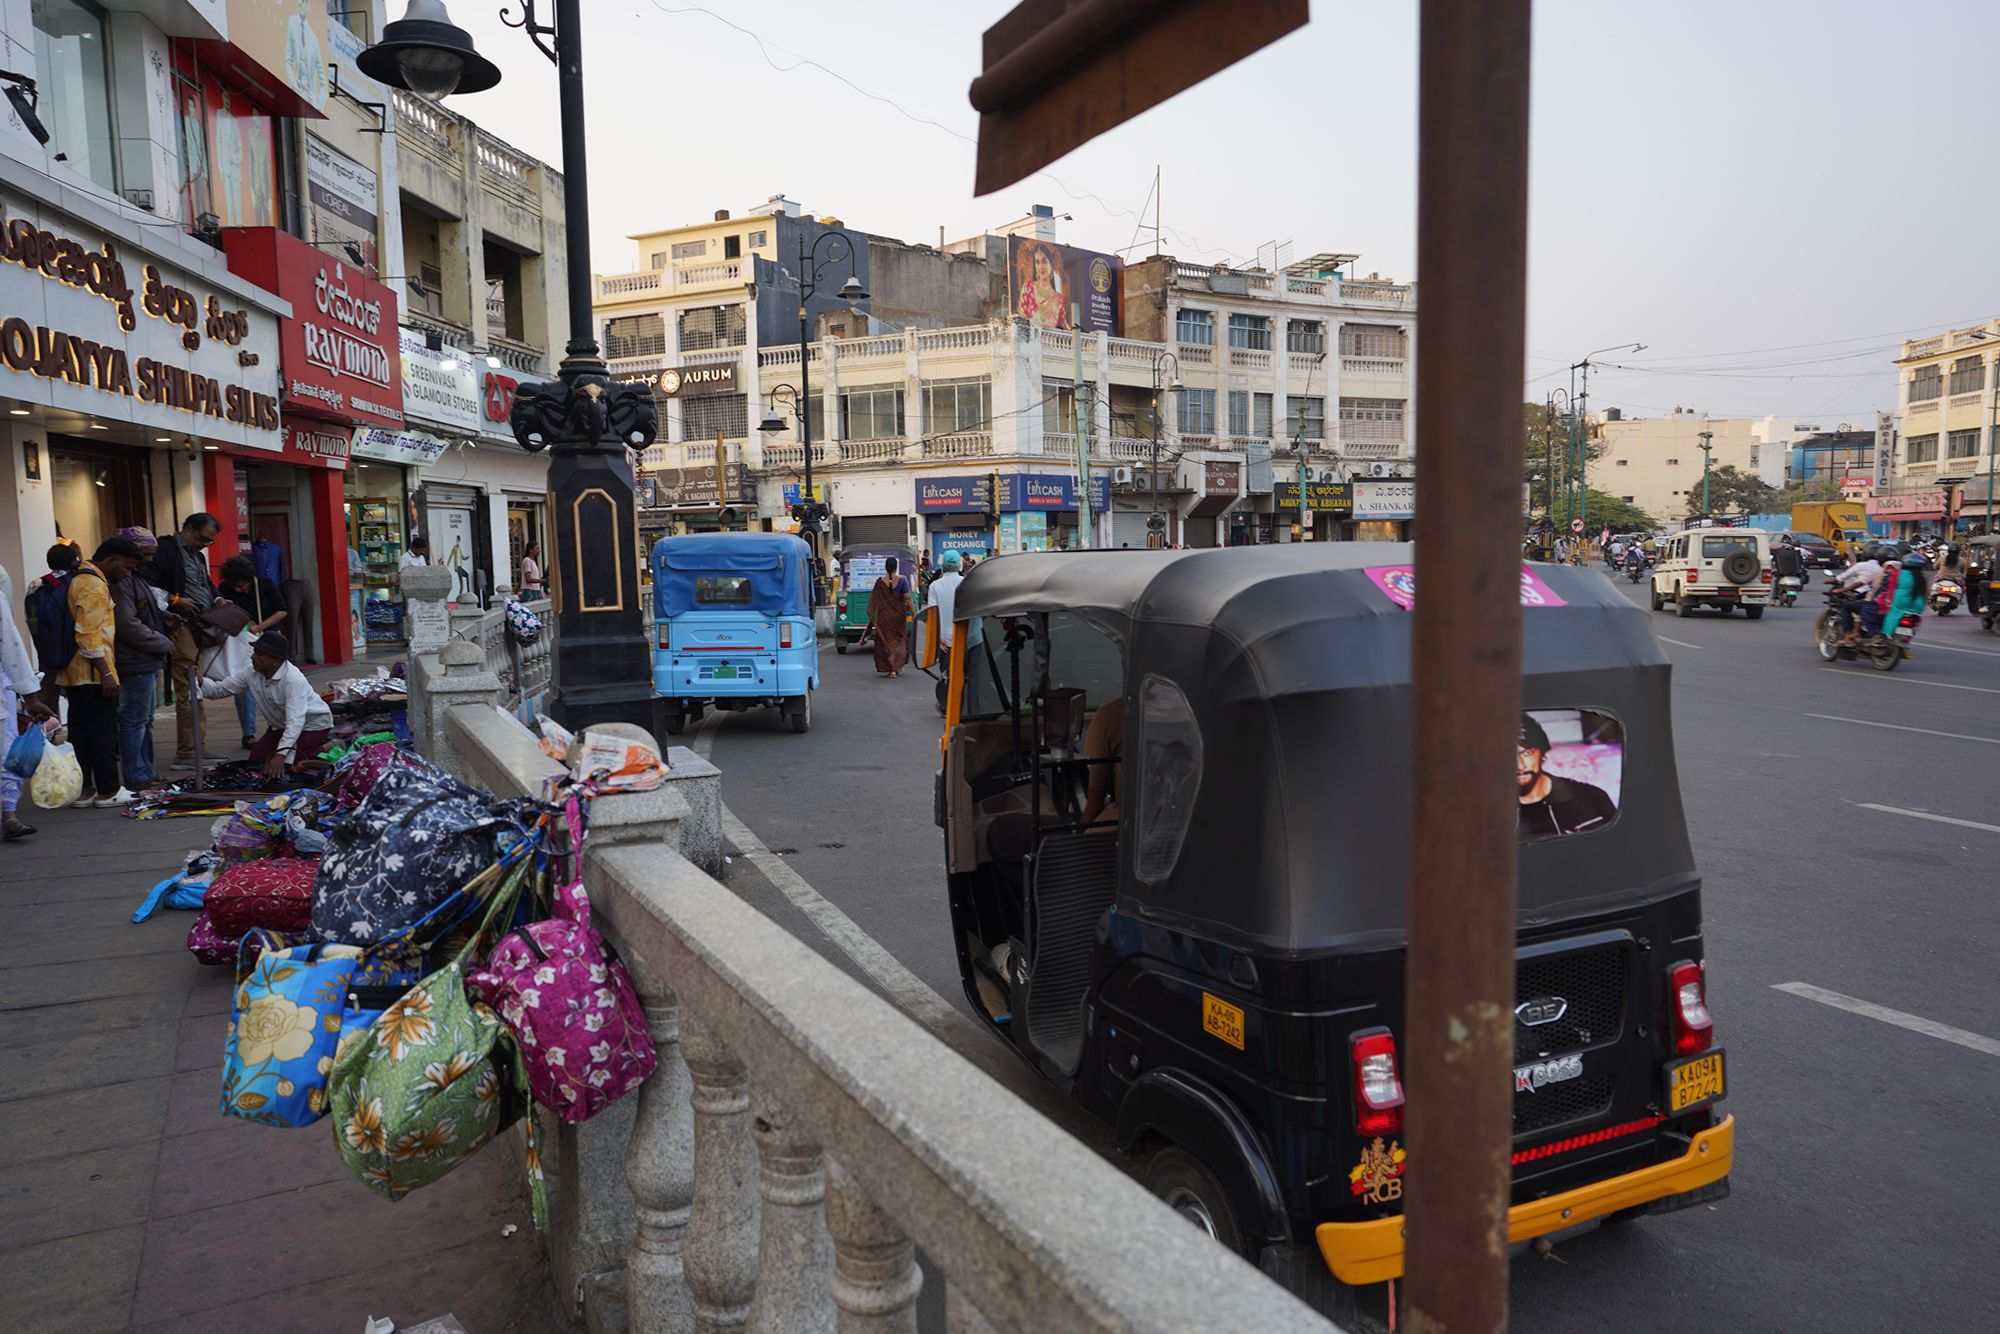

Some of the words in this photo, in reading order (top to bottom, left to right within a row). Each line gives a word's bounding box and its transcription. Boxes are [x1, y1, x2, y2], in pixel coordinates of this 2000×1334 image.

[303, 321, 391, 384] Raymond
[0, 317, 134, 396] OJAYYA
[136, 356, 223, 418] SHILPA
[225, 384, 279, 431] SILKS
[410, 363, 457, 391] SREENIVASA
[684, 368, 731, 383] AURUM
[413, 383, 452, 407] GLAMOUR
[453, 395, 477, 414] STORES
[295, 431, 349, 458] Raymond
[1279, 499, 1318, 507] NAVARNA
[942, 541, 986, 549] EXCHANGE
[1526, 1003, 1557, 1021] RE
[1207, 1013, 1241, 1042] AB-7242
[1680, 1056, 1717, 1084] KA09A
[1680, 1076, 1718, 1106] B7242
[1363, 1178, 1402, 1206] RCB
